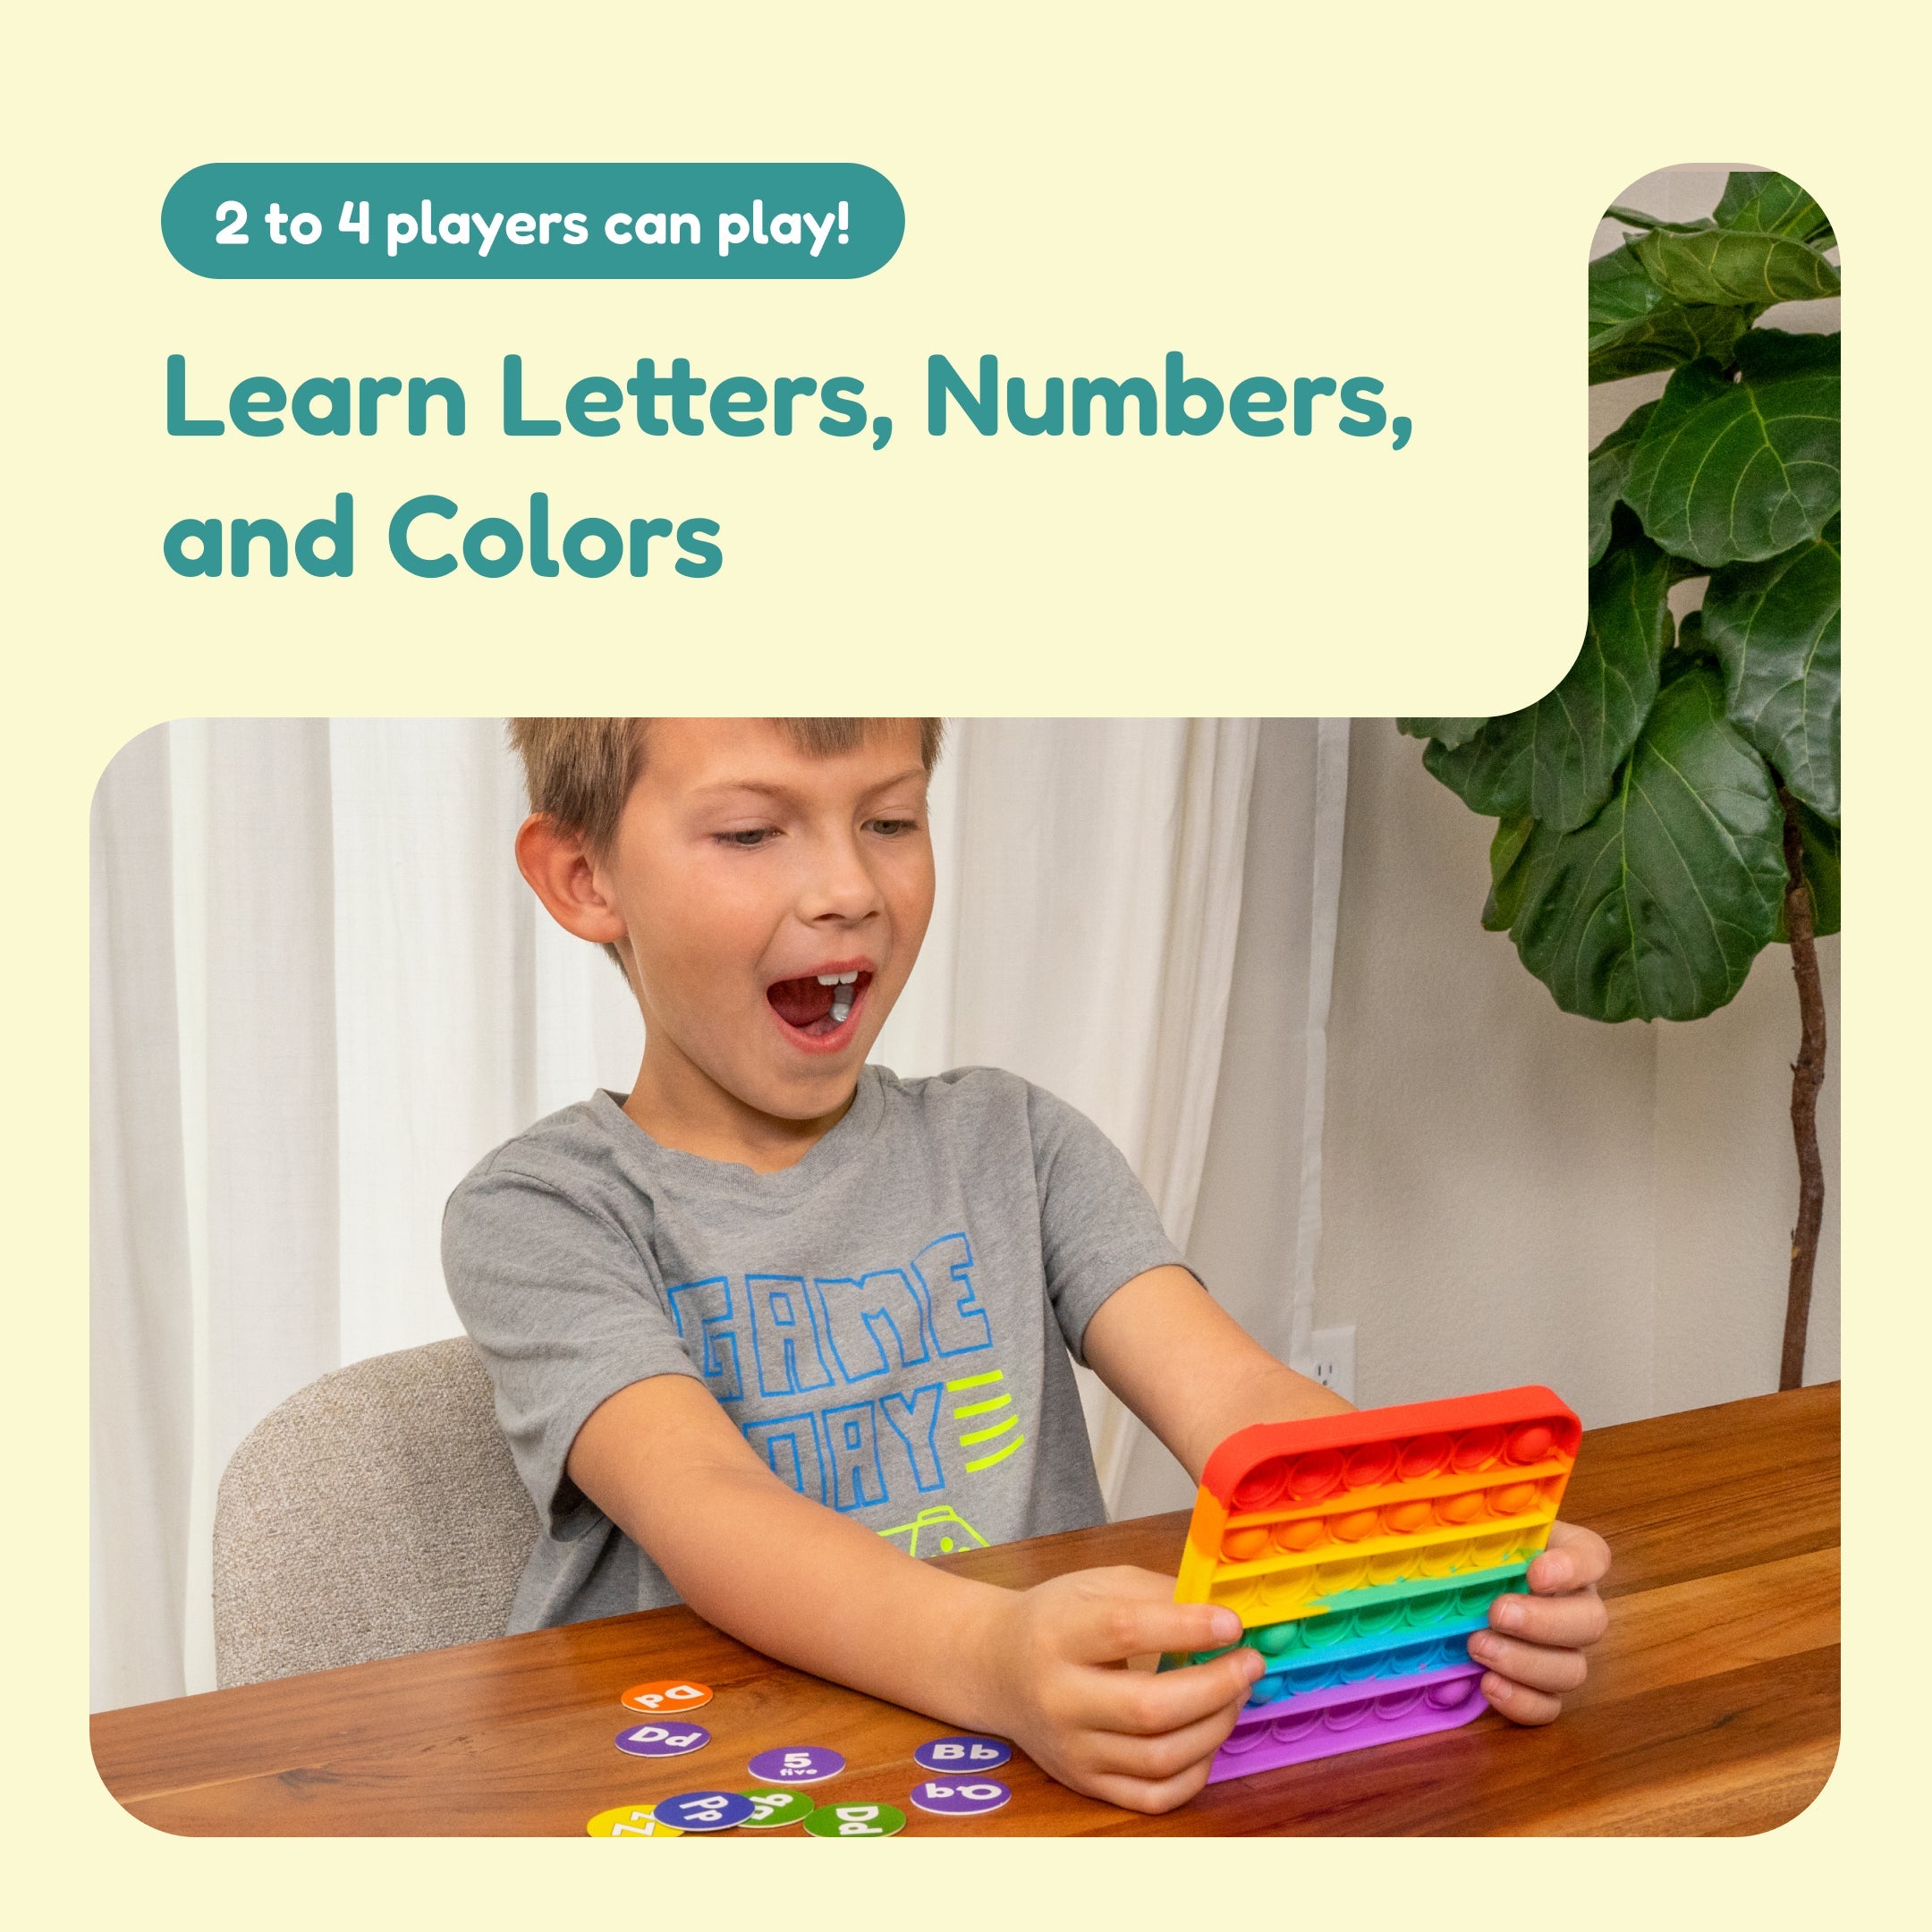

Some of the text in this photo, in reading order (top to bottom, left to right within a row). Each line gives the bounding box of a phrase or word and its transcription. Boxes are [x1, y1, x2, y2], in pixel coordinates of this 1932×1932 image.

[665, 1232, 994, 1402] GAME
[628, 1726, 702, 1748] Dd
[784, 1752, 812, 1768] 5
[932, 1744, 999, 1759] Bb
[780, 1768, 818, 1776] five
[679, 1796, 729, 1822] Pp
[835, 1806, 883, 1835] Dd
